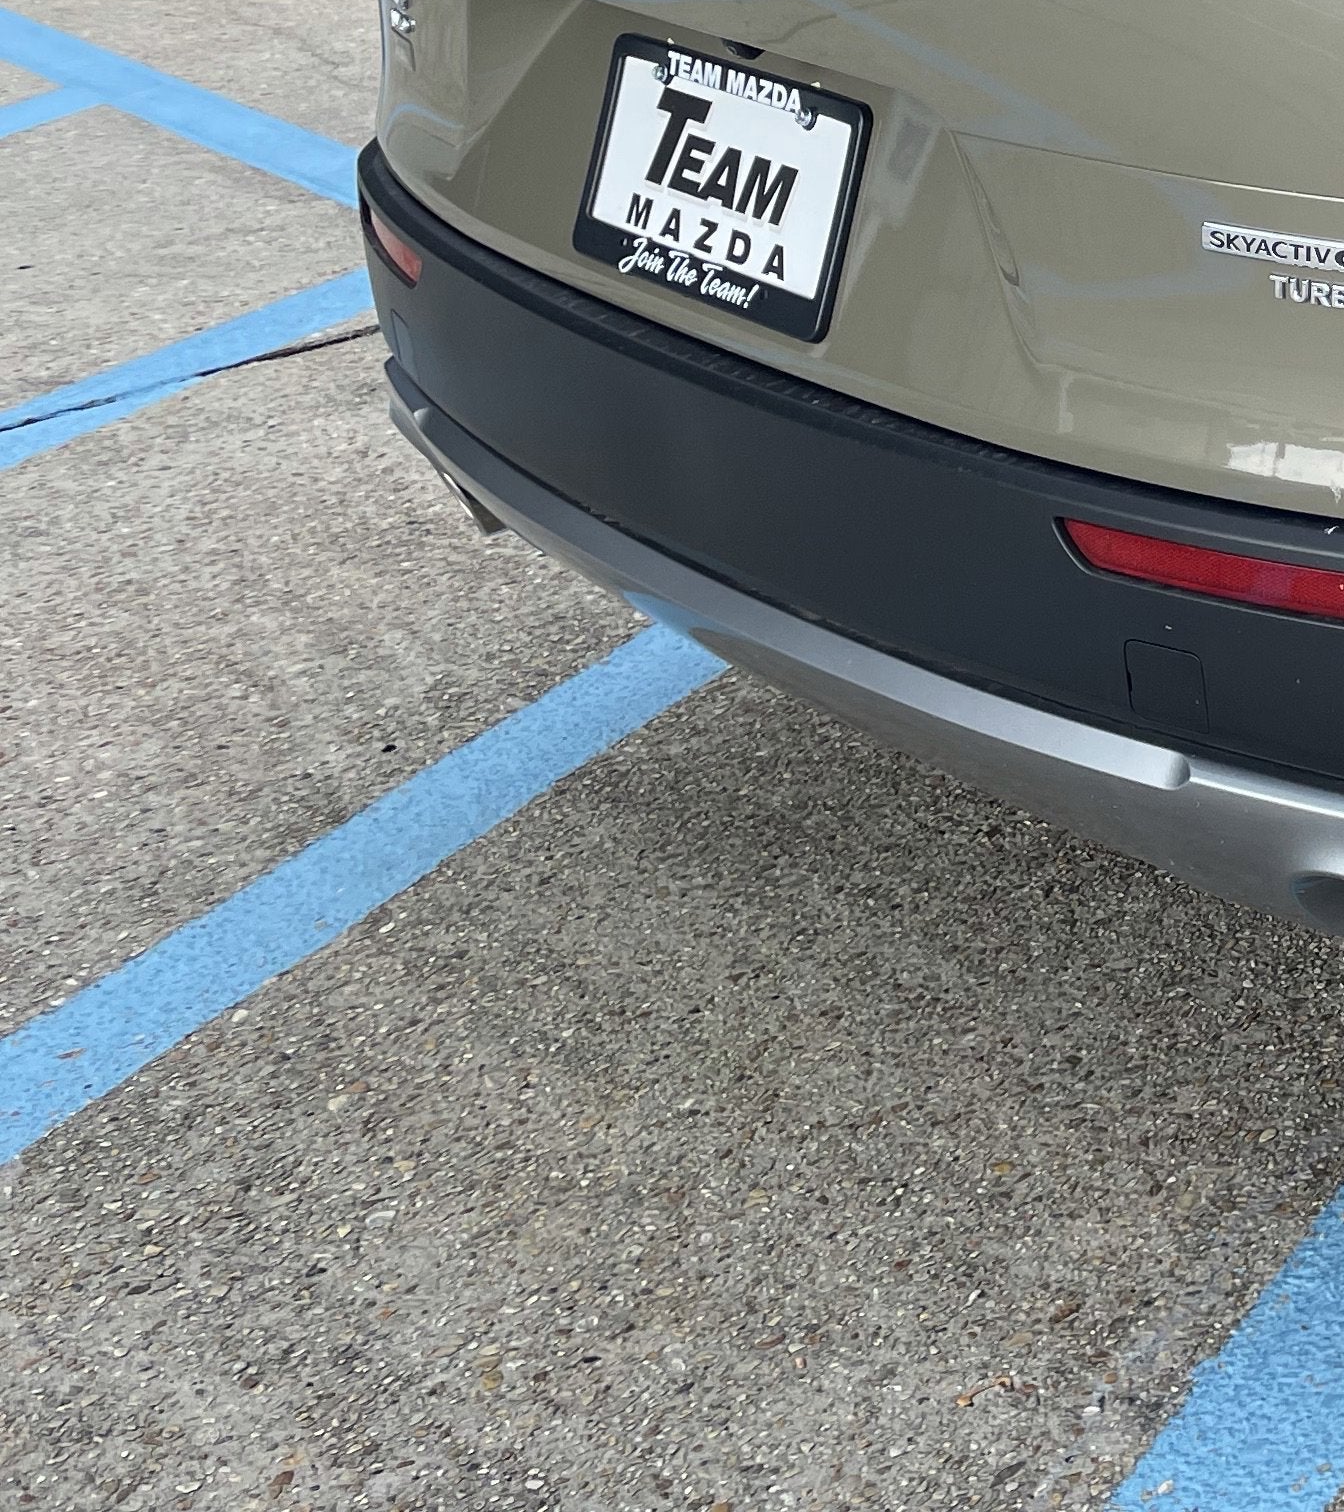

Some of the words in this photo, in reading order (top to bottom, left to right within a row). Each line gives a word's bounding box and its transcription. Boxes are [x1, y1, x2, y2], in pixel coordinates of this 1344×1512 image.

[667, 50, 723, 88] TEAM
[726, 69, 802, 114] MAZDA
[644, 87, 799, 227] TEAM
[618, 238, 665, 274] Join
[666, 250, 698, 287] The
[700, 263, 760, 309] Team!
[625, 192, 785, 281] MAZDA
